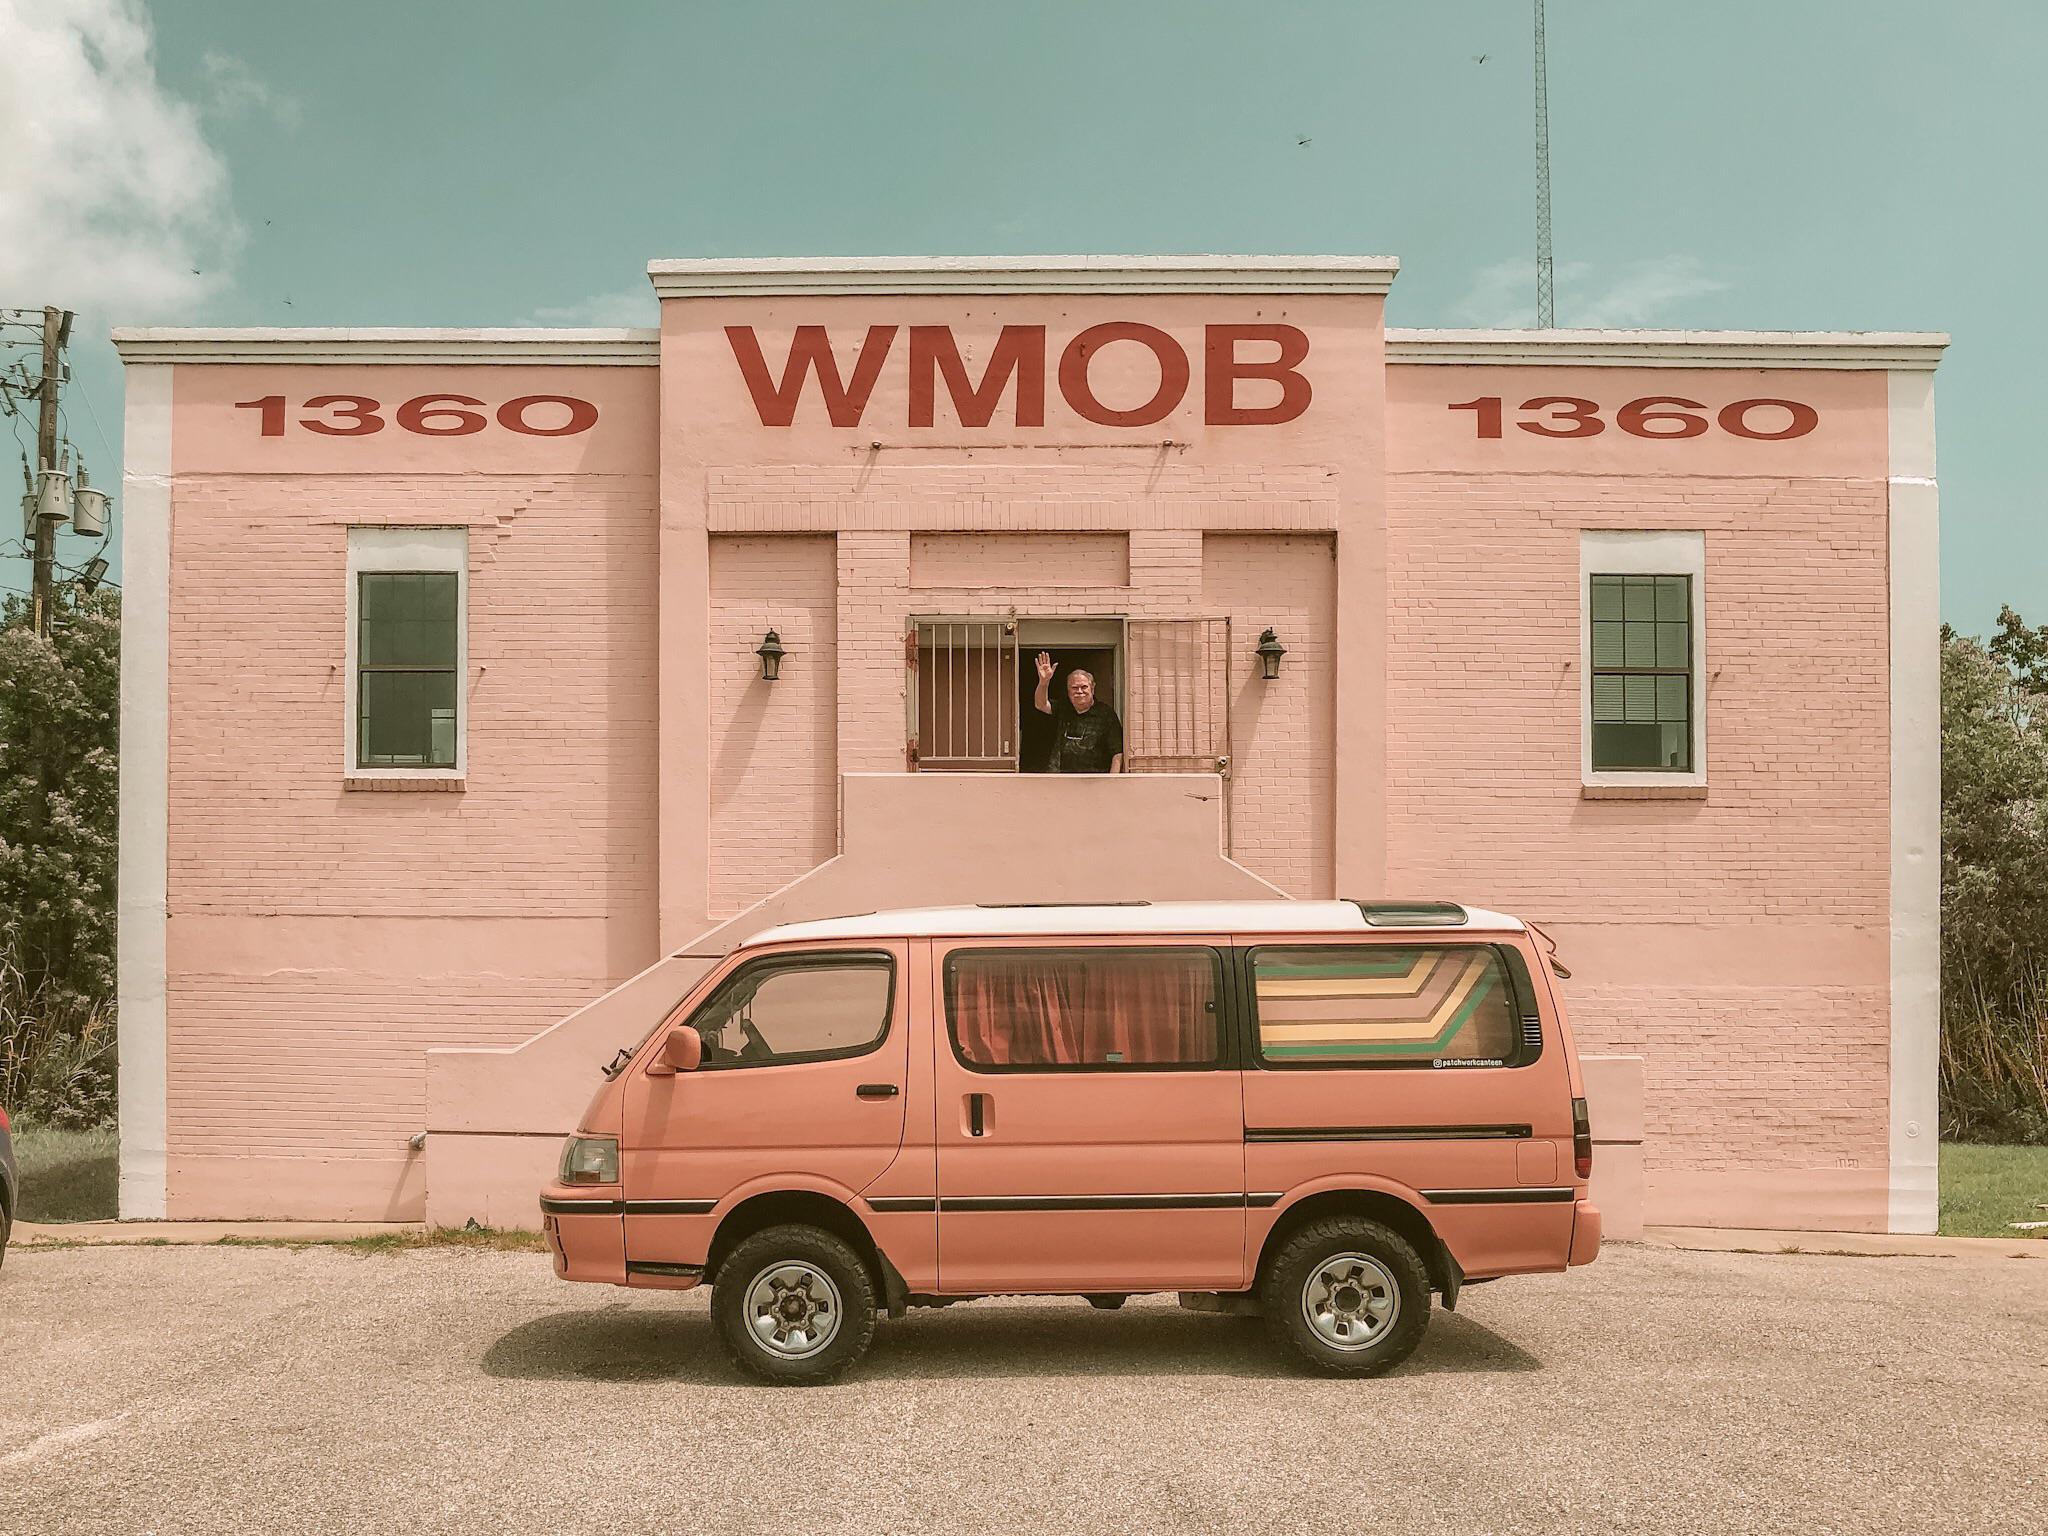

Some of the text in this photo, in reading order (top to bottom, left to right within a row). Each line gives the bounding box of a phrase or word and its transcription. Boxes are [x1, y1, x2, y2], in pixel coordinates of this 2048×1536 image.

[725, 324, 1311, 427] WMOB
[235, 394, 597, 437] 1360
[1447, 396, 1818, 440] 1360
[1442, 1059, 1502, 1067] patchworkcanteen
